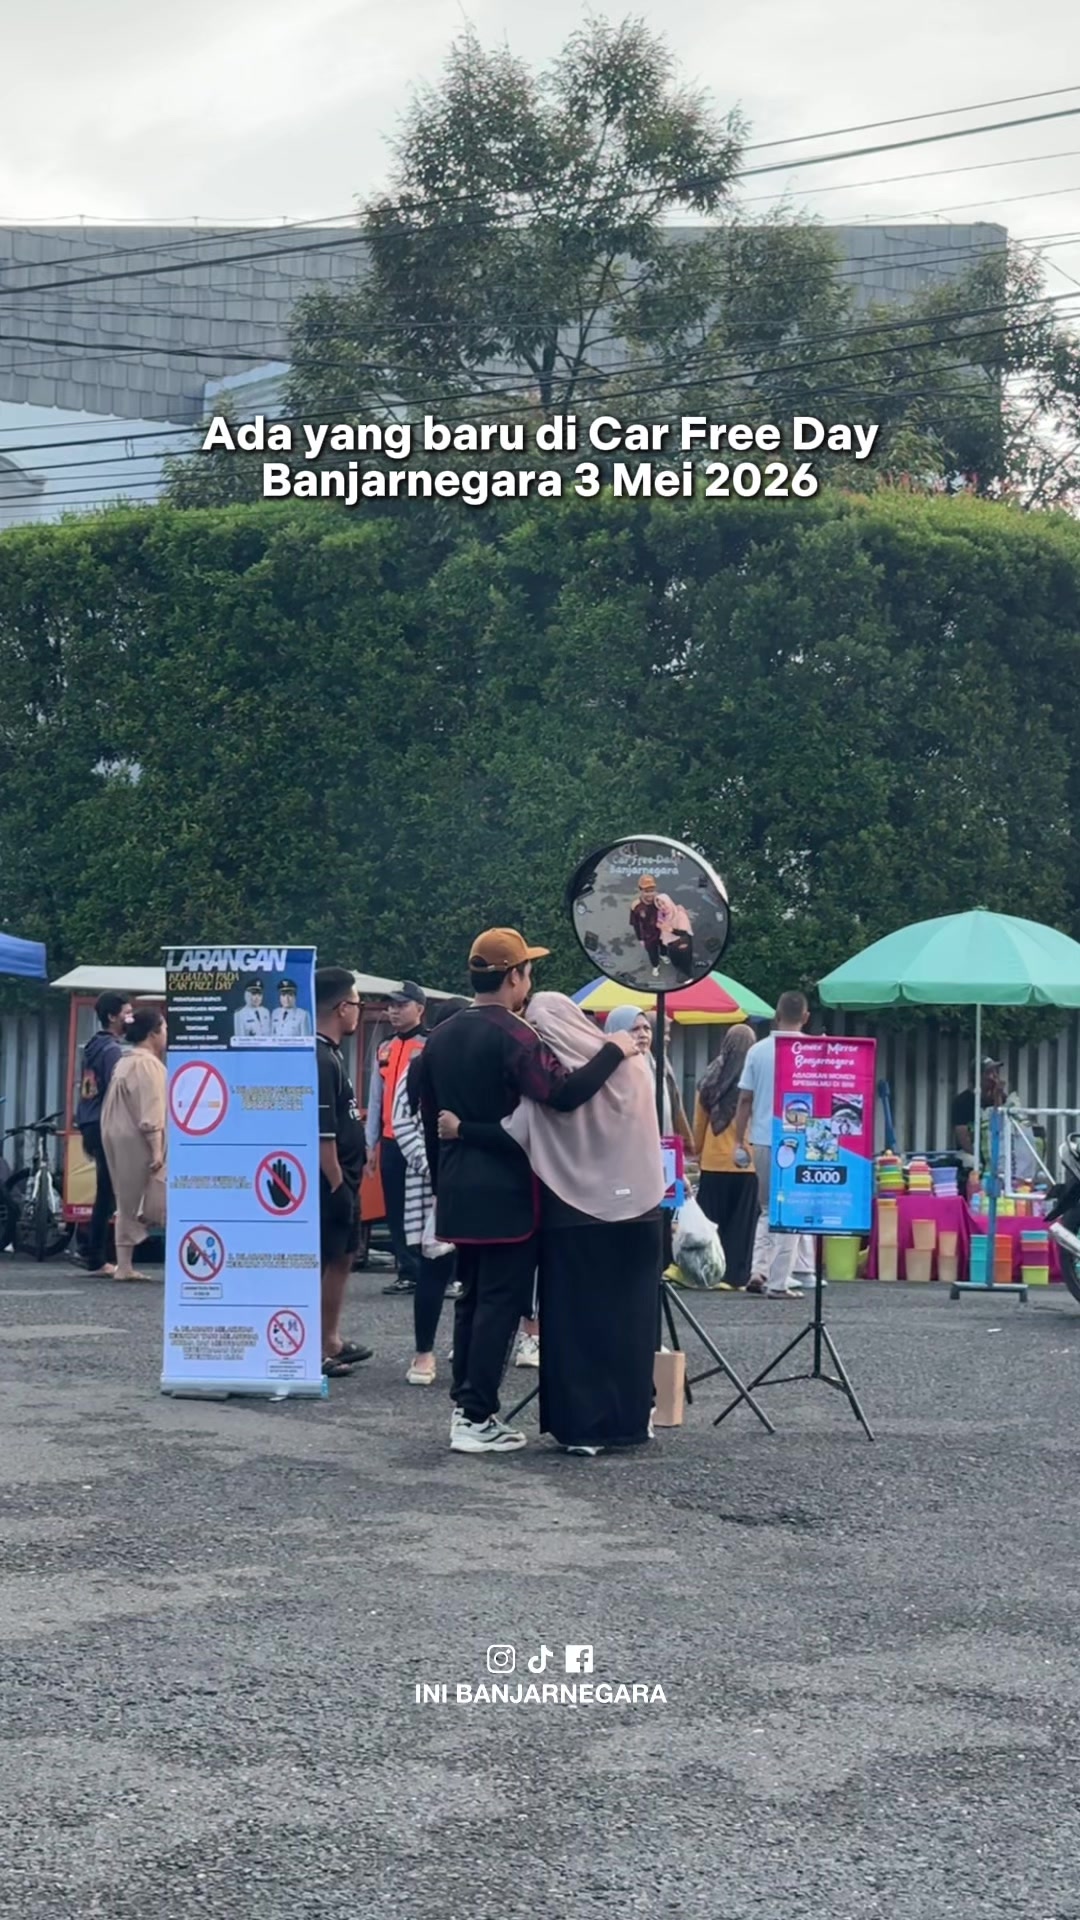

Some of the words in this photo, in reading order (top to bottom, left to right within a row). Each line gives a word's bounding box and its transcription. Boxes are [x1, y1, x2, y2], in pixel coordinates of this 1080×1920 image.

[166, 949, 288, 972] LARANGAN
[168, 971, 214, 982] KEGIATAN
[214, 971, 240, 982] PADA
[168, 981, 188, 991] CAR
[188, 981, 213, 991] FREE
[214, 981, 234, 991] DAY
[826, 1043, 859, 1055] Mirror
[794, 1054, 855, 1070] Banjarnegara
[801, 1170, 841, 1184] 3.000
